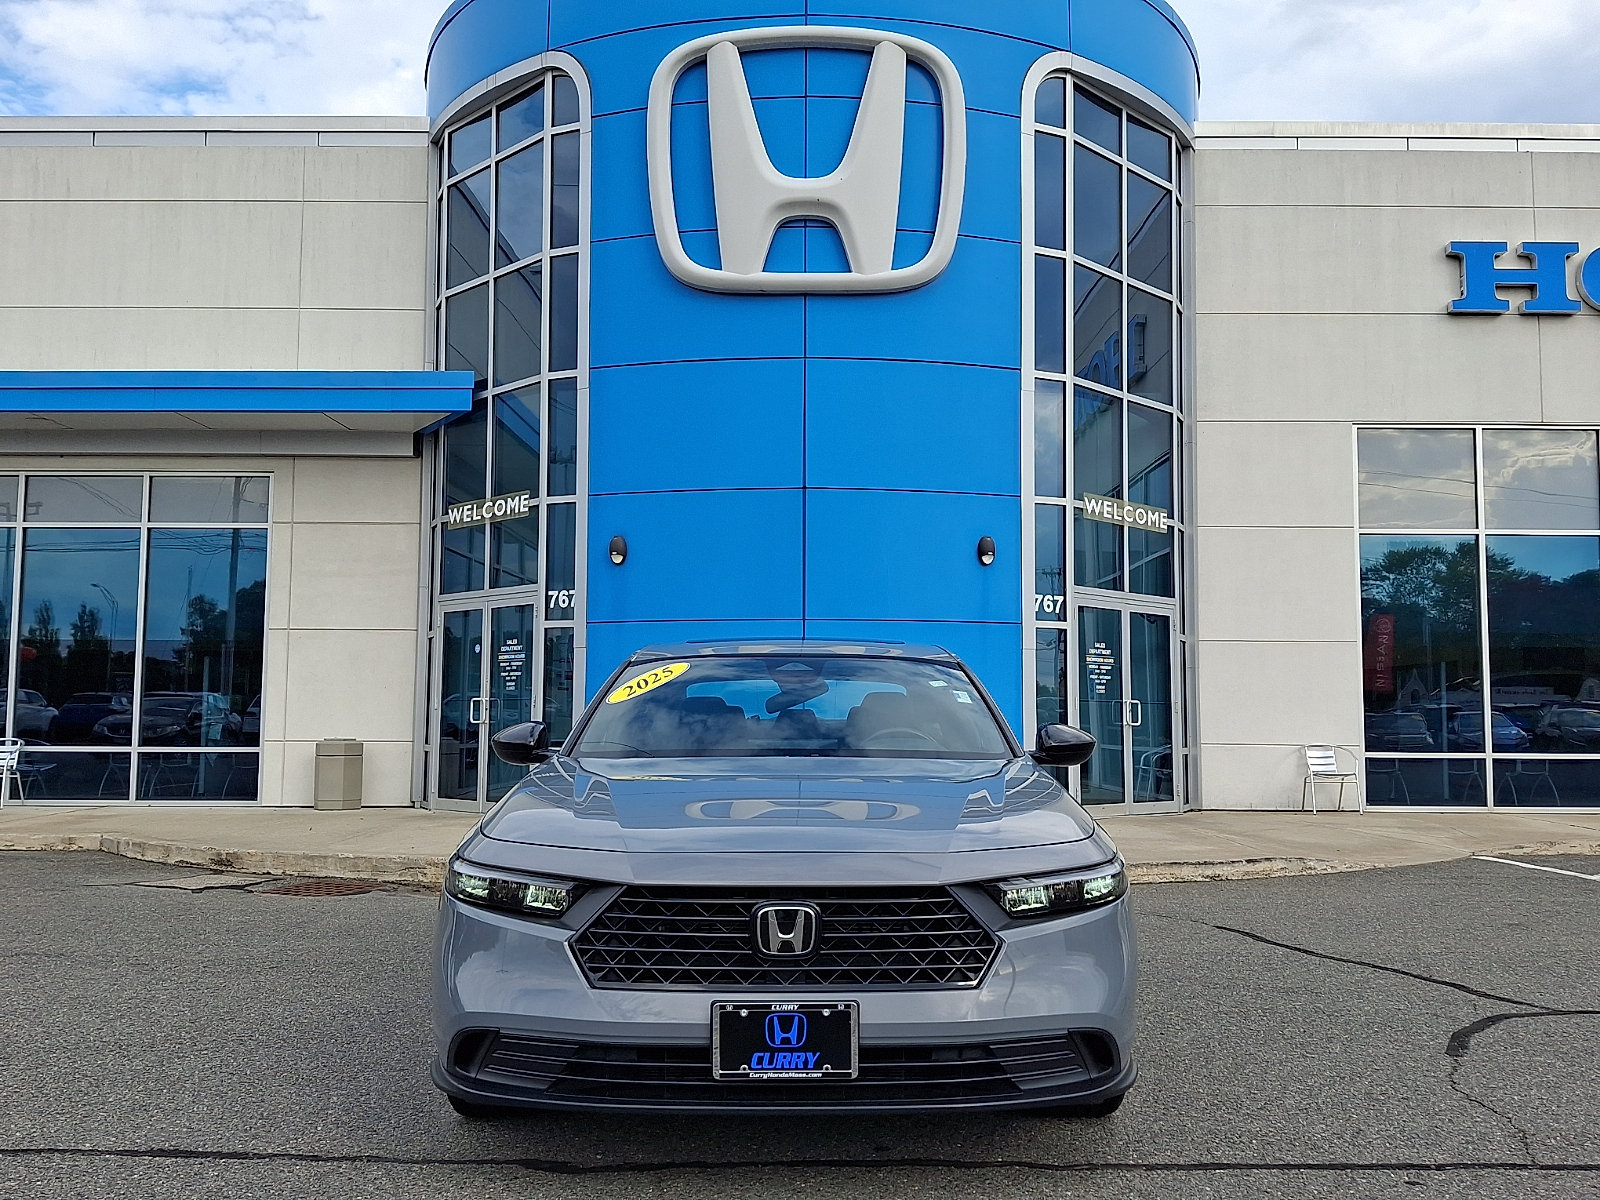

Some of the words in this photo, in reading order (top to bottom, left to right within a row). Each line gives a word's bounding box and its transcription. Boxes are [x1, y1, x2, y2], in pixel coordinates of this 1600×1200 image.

[448, 494, 530, 524] WELCOME
[1084, 496, 1168, 530] WELCOME
[548, 590, 576, 609] 767
[1035, 594, 1064, 614] 767
[622, 666, 674, 698] 2025
[751, 1052, 820, 1069] CURRY
